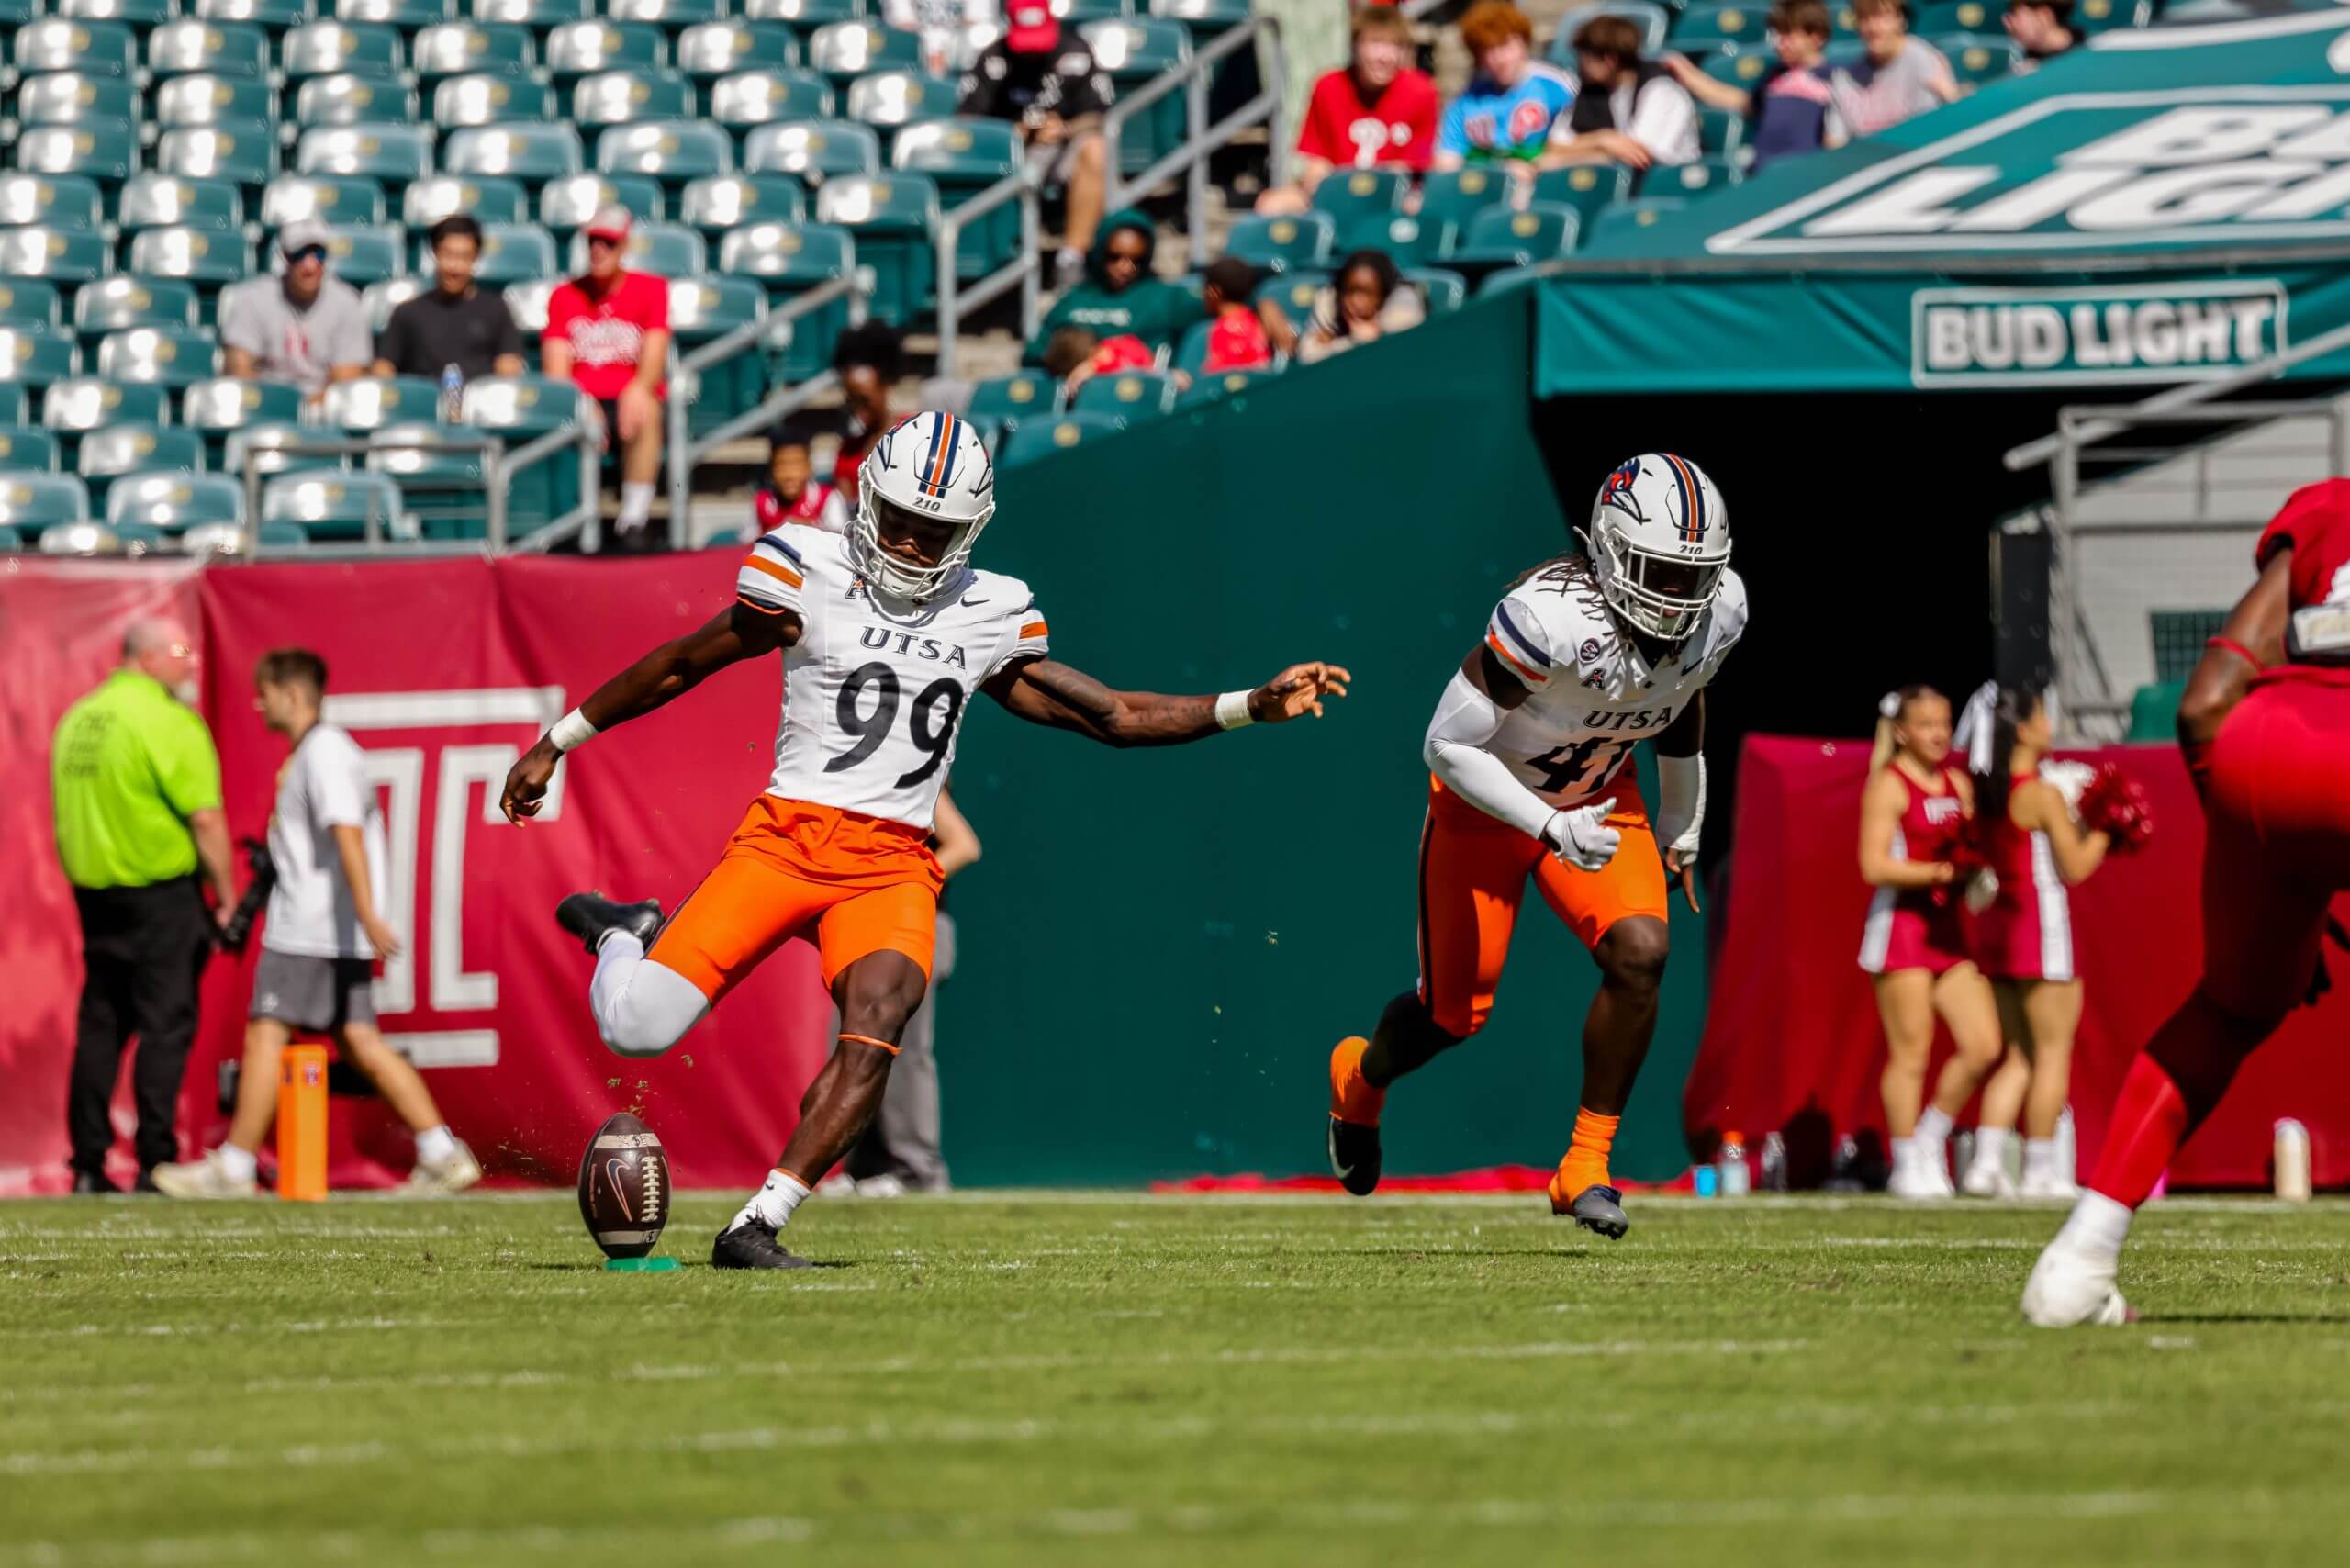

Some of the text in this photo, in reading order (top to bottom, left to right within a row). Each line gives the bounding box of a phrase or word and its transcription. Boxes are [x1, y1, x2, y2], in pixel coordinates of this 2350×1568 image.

[1927, 297, 2275, 370] BUD LIGHT
[912, 496, 941, 513] 210
[1678, 543, 1704, 555] 210
[859, 625, 967, 670] UTSA
[822, 661, 964, 789] 99
[1583, 706, 1673, 731] UTSA
